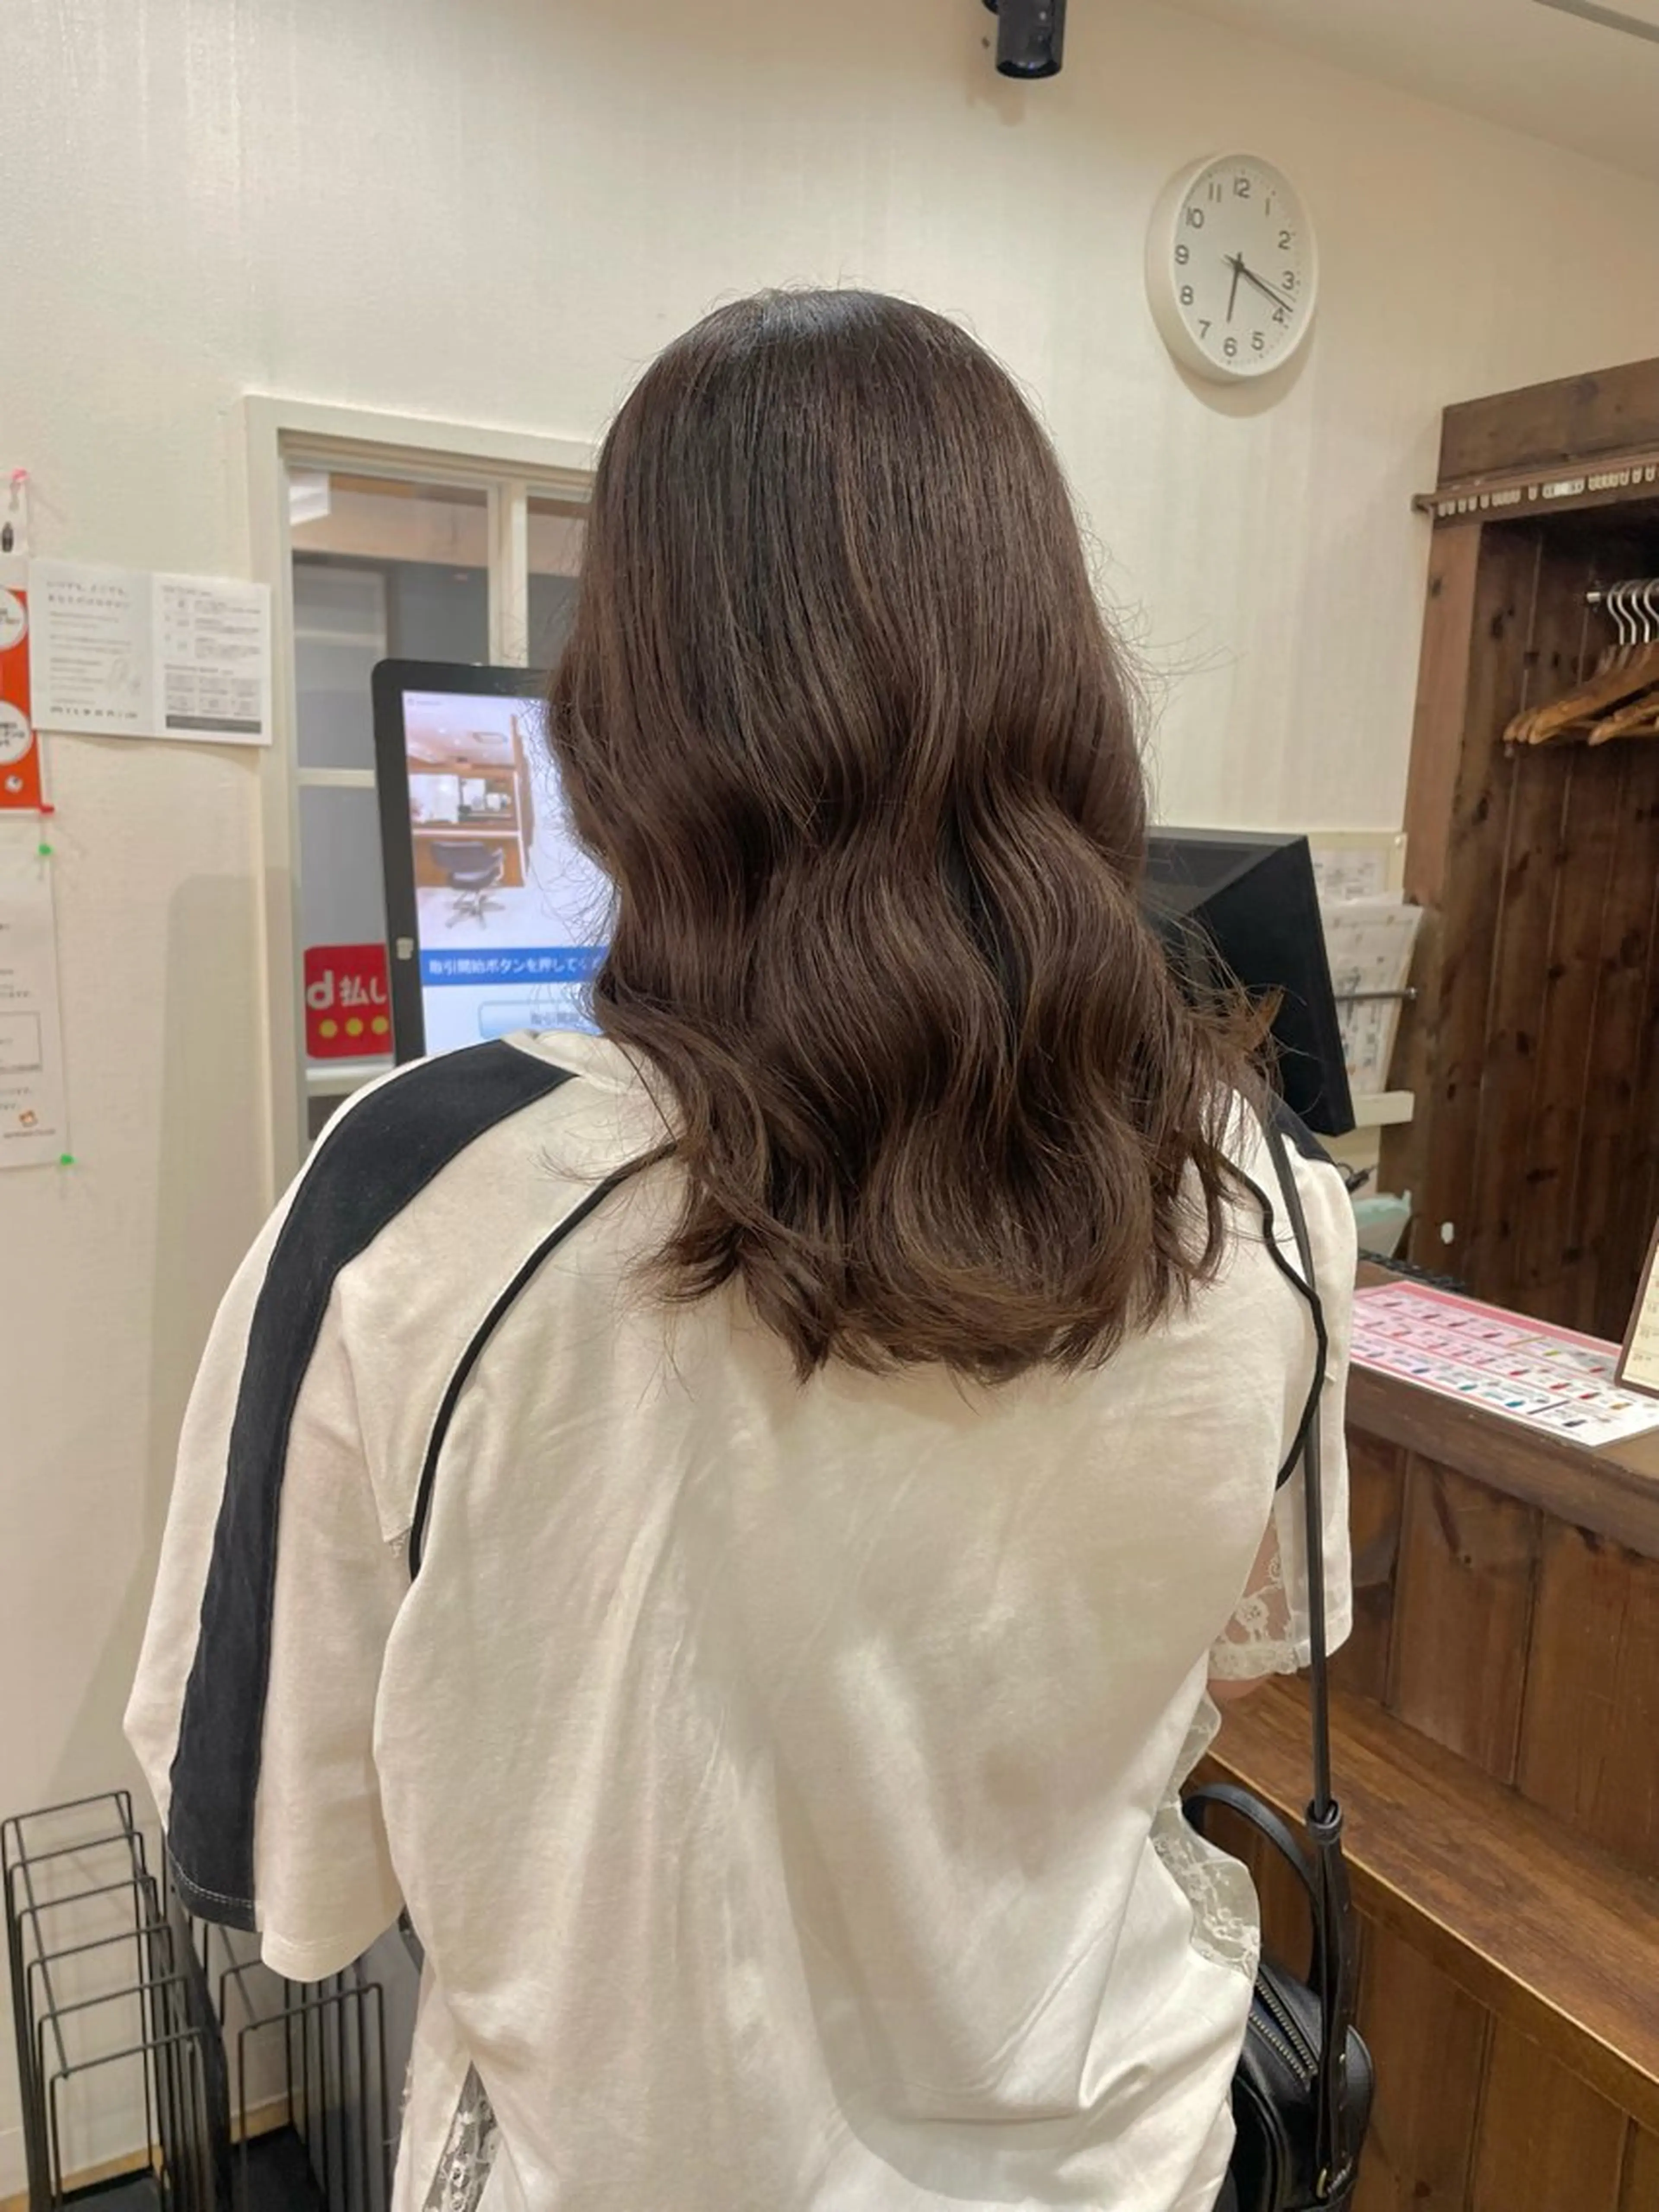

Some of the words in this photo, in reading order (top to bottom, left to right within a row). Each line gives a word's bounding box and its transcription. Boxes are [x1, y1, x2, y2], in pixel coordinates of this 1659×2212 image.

[1208, 182, 1221, 203] 11
[1234, 177, 1251, 198] 12
[1265, 197, 1270, 216] 1
[1185, 207, 1204, 229] 10
[1278, 230, 1291, 250] 2
[1175, 245, 1189, 264] 9
[1281, 271, 1294, 290] 3
[1181, 286, 1193, 305] 8
[1271, 306, 1285, 324] 4
[1198, 320, 1212, 339] 7
[1223, 337, 1237, 356] 6
[1252, 331, 1265, 351] 5
